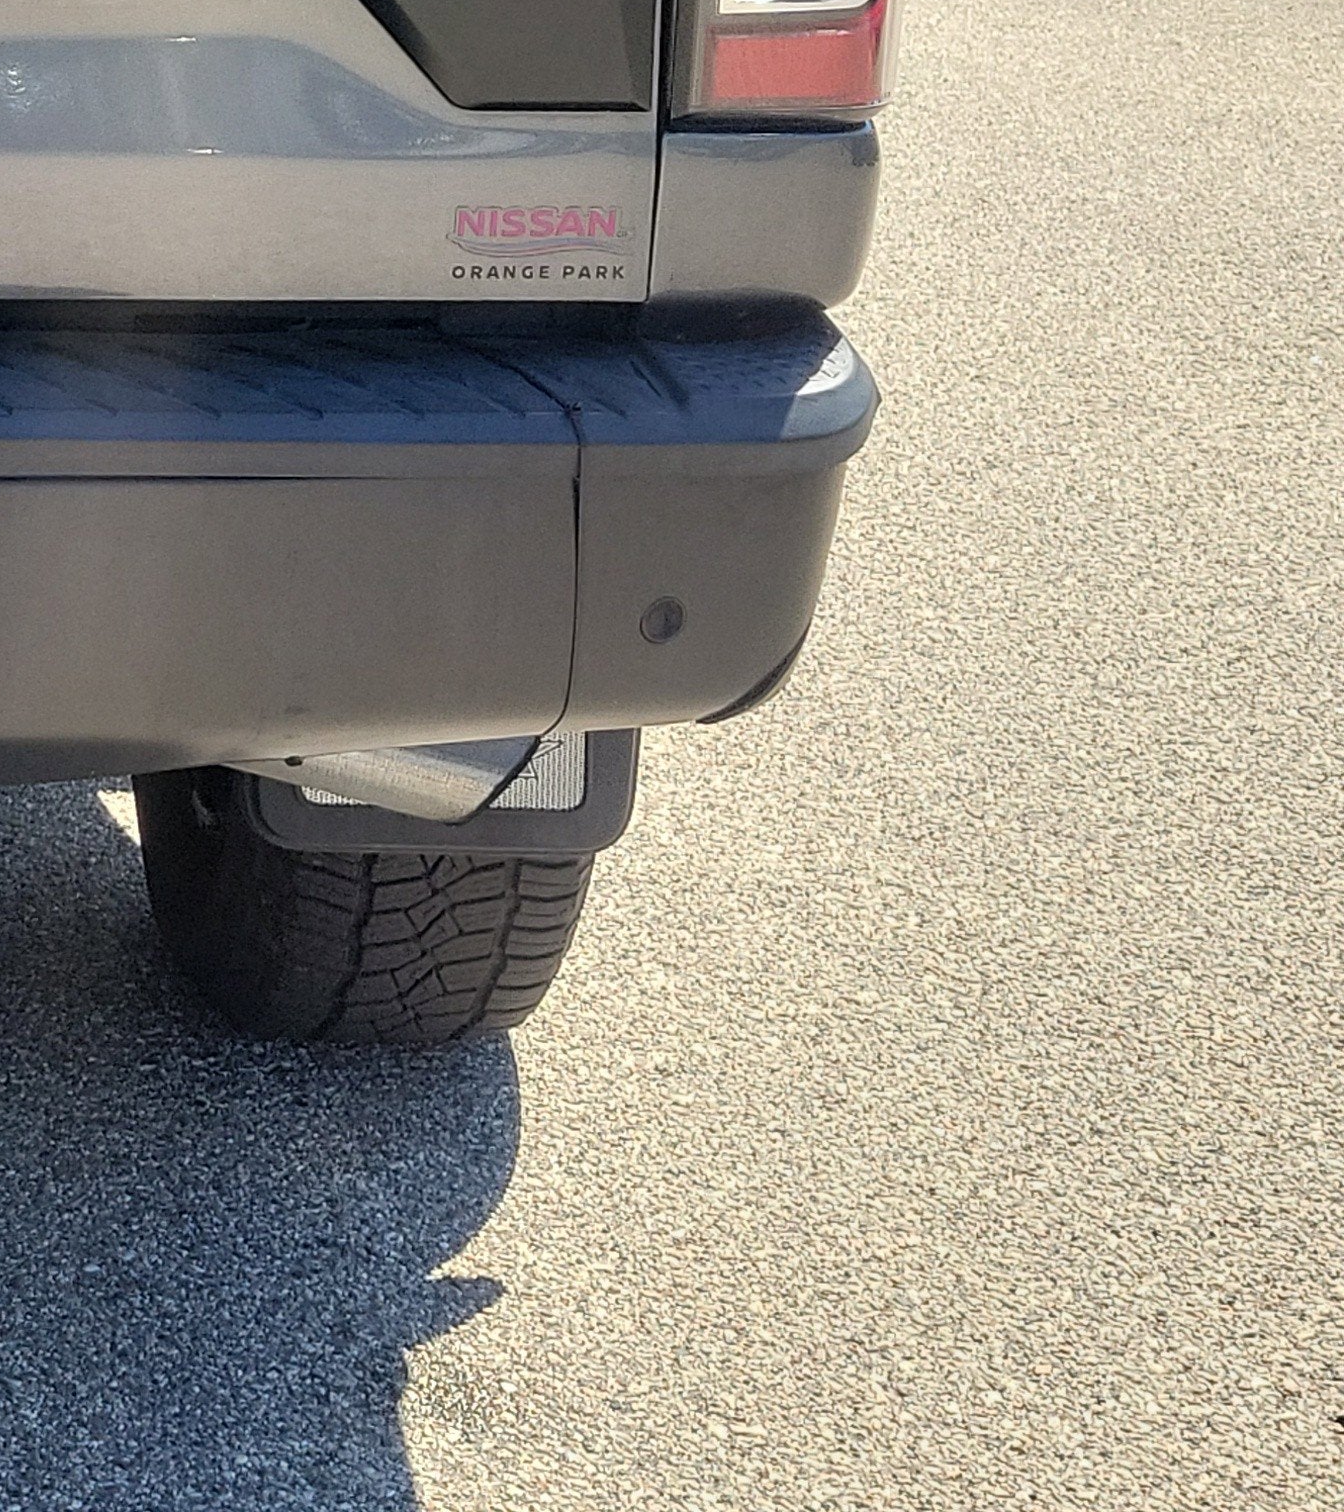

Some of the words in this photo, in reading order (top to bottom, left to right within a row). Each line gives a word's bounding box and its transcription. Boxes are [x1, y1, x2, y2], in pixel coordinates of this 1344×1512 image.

[456, 209, 616, 238] NISSAN
[451, 265, 550, 280] ORANGE
[562, 265, 625, 280] PARK
